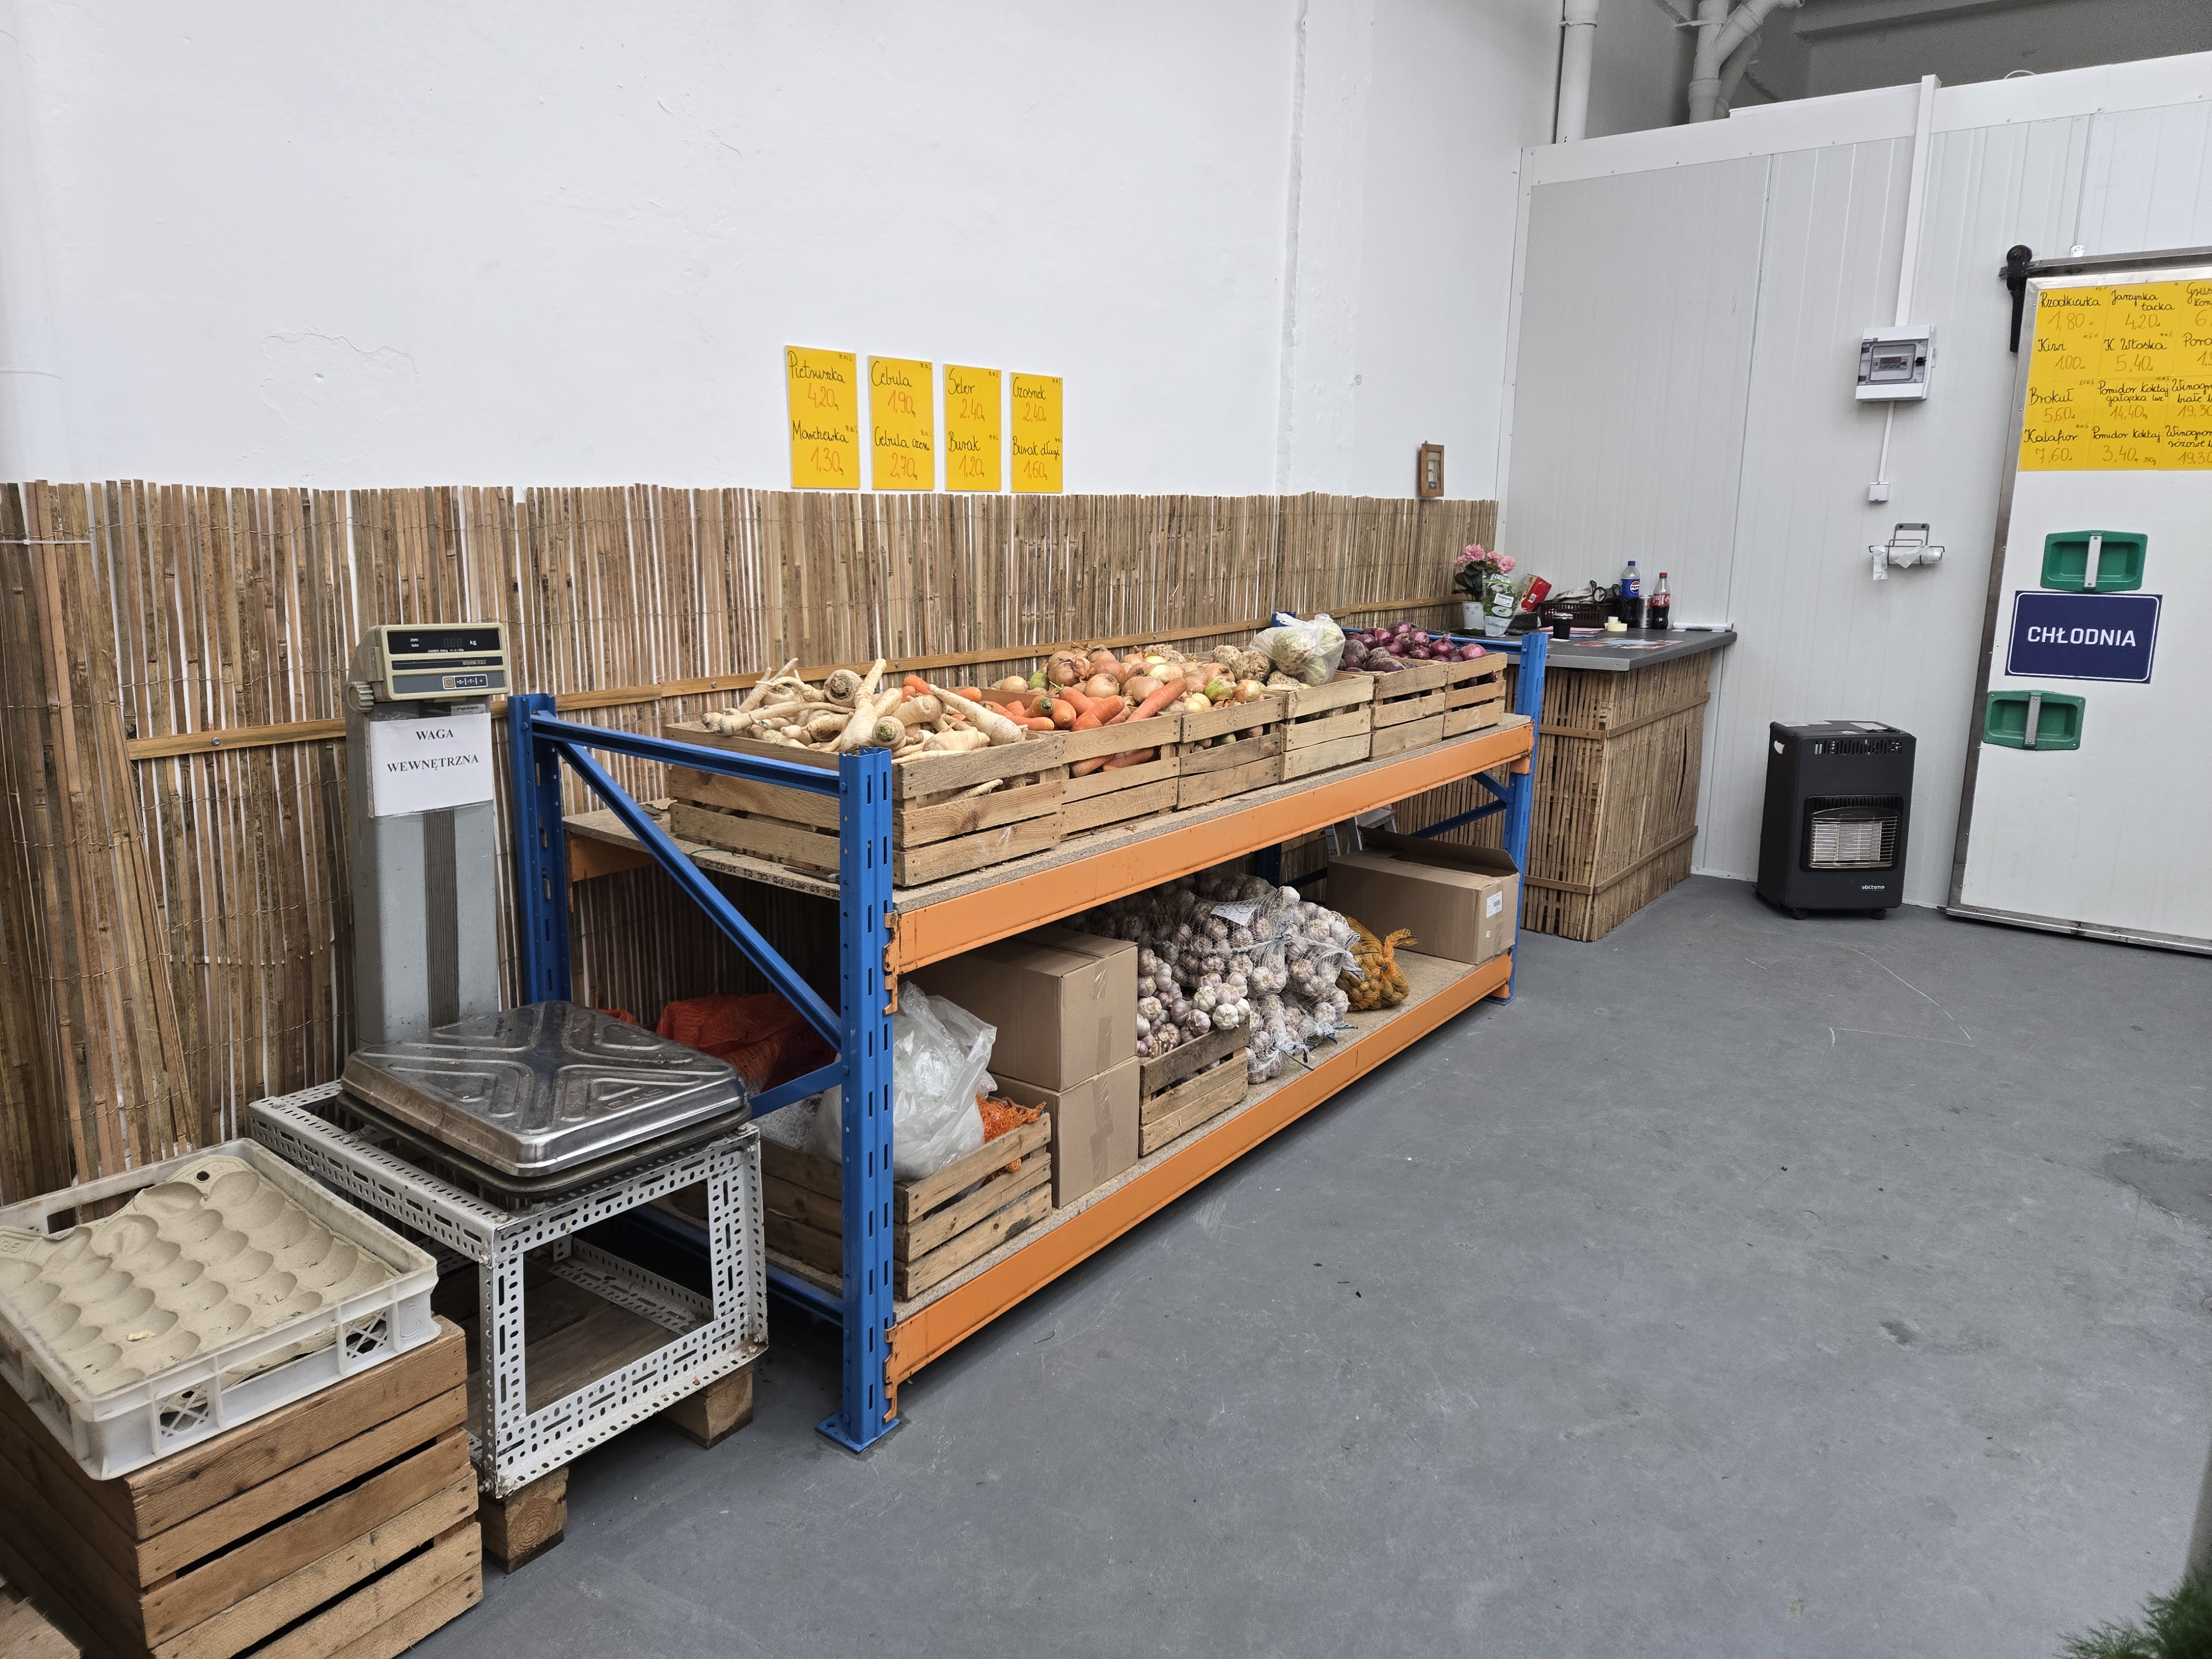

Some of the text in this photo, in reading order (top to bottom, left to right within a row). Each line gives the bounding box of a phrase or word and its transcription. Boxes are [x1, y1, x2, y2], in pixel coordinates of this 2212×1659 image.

[2111, 290, 2159, 306] Jarzynka
[2141, 302, 2176, 311] tacka
[2048, 311, 2084, 332] 1,80
[2125, 314, 2157, 330] 4,20
[2038, 338, 2066, 352] Kiwi
[787, 351, 846, 383] Pietruszka
[2056, 355, 2081, 370] 1,00
[2115, 354, 2151, 372] 5,40
[871, 361, 912, 387] Cebula
[948, 368, 975, 395] Seler
[808, 383, 834, 409] 4,20
[1013, 377, 1046, 400] Czosnek
[2028, 388, 2074, 405] Brokuł
[2097, 380, 2137, 395] Pomidor
[888, 390, 912, 414] 1,90
[2177, 393, 2202, 403] białe
[959, 398, 983, 419] 2,40
[1023, 402, 1044, 422] 2,40
[2043, 407, 2072, 422] 5,60
[2110, 405, 2144, 420] 14,40
[793, 420, 849, 443] Marchewka
[875, 426, 910, 448] Cebula
[2023, 429, 2079, 445] Kalafior
[2092, 426, 2128, 439] Pomidor
[948, 431, 980, 452] Burak
[1013, 436, 1060, 461] Burak długi
[811, 447, 840, 473] 1,30
[2036, 447, 2069, 464] 7,60
[2103, 445, 2136, 462] 3,40
[890, 452, 915, 479] 2,70
[959, 455, 983, 478] 1,20
[1024, 460, 1045, 479] 1,60
[2027, 626, 2136, 646] CHŁODNIA
[416, 729, 453, 740] WAGA
[387, 754, 479, 773] WEWNĘTRZNA
[743, 868, 753, 878] E1
[757, 872, 768, 881] CE
